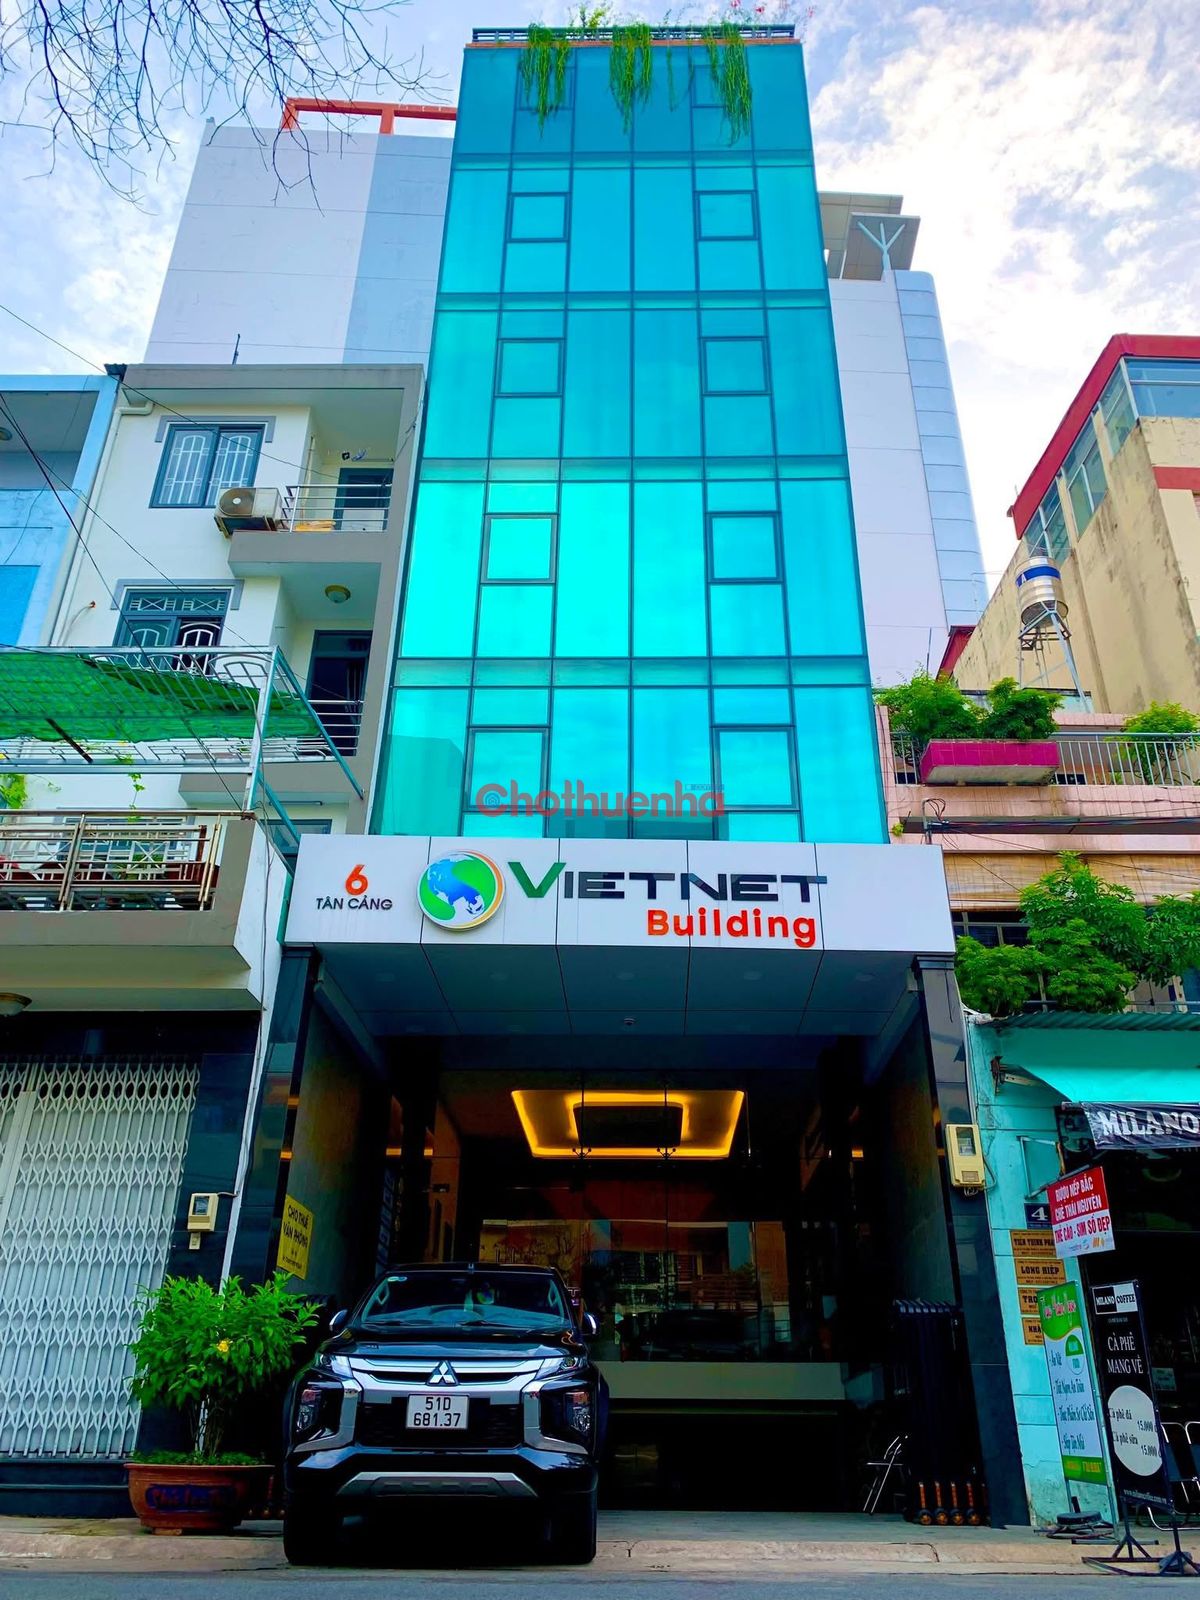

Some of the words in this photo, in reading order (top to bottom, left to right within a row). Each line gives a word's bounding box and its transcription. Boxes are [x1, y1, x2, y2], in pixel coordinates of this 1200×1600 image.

[345, 864, 369, 896] 6
[508, 861, 828, 903] VIETNET
[316, 897, 344, 911] TÂN
[347, 894, 393, 911] CẢNG
[647, 906, 816, 948] Building
[1097, 1110, 1200, 1136] MILANO
[1080, 1173, 1094, 1194] BẮC
[1031, 1206, 1048, 1221] 4
[1087, 1213, 1097, 1235] SỐ
[1096, 1215, 1110, 1235] ĐẸP
[1096, 1296, 1115, 1306] MILANO
[1116, 1294, 1136, 1304] COFFEE
[1107, 1331, 1120, 1351] CÀ
[1119, 1331, 1136, 1351] PHÊ
[1107, 1358, 1131, 1374] MANG
[1131, 1354, 1144, 1374] VỀ
[425, 1397, 451, 1411] 51D
[413, 1412, 461, 1427] 681.37
